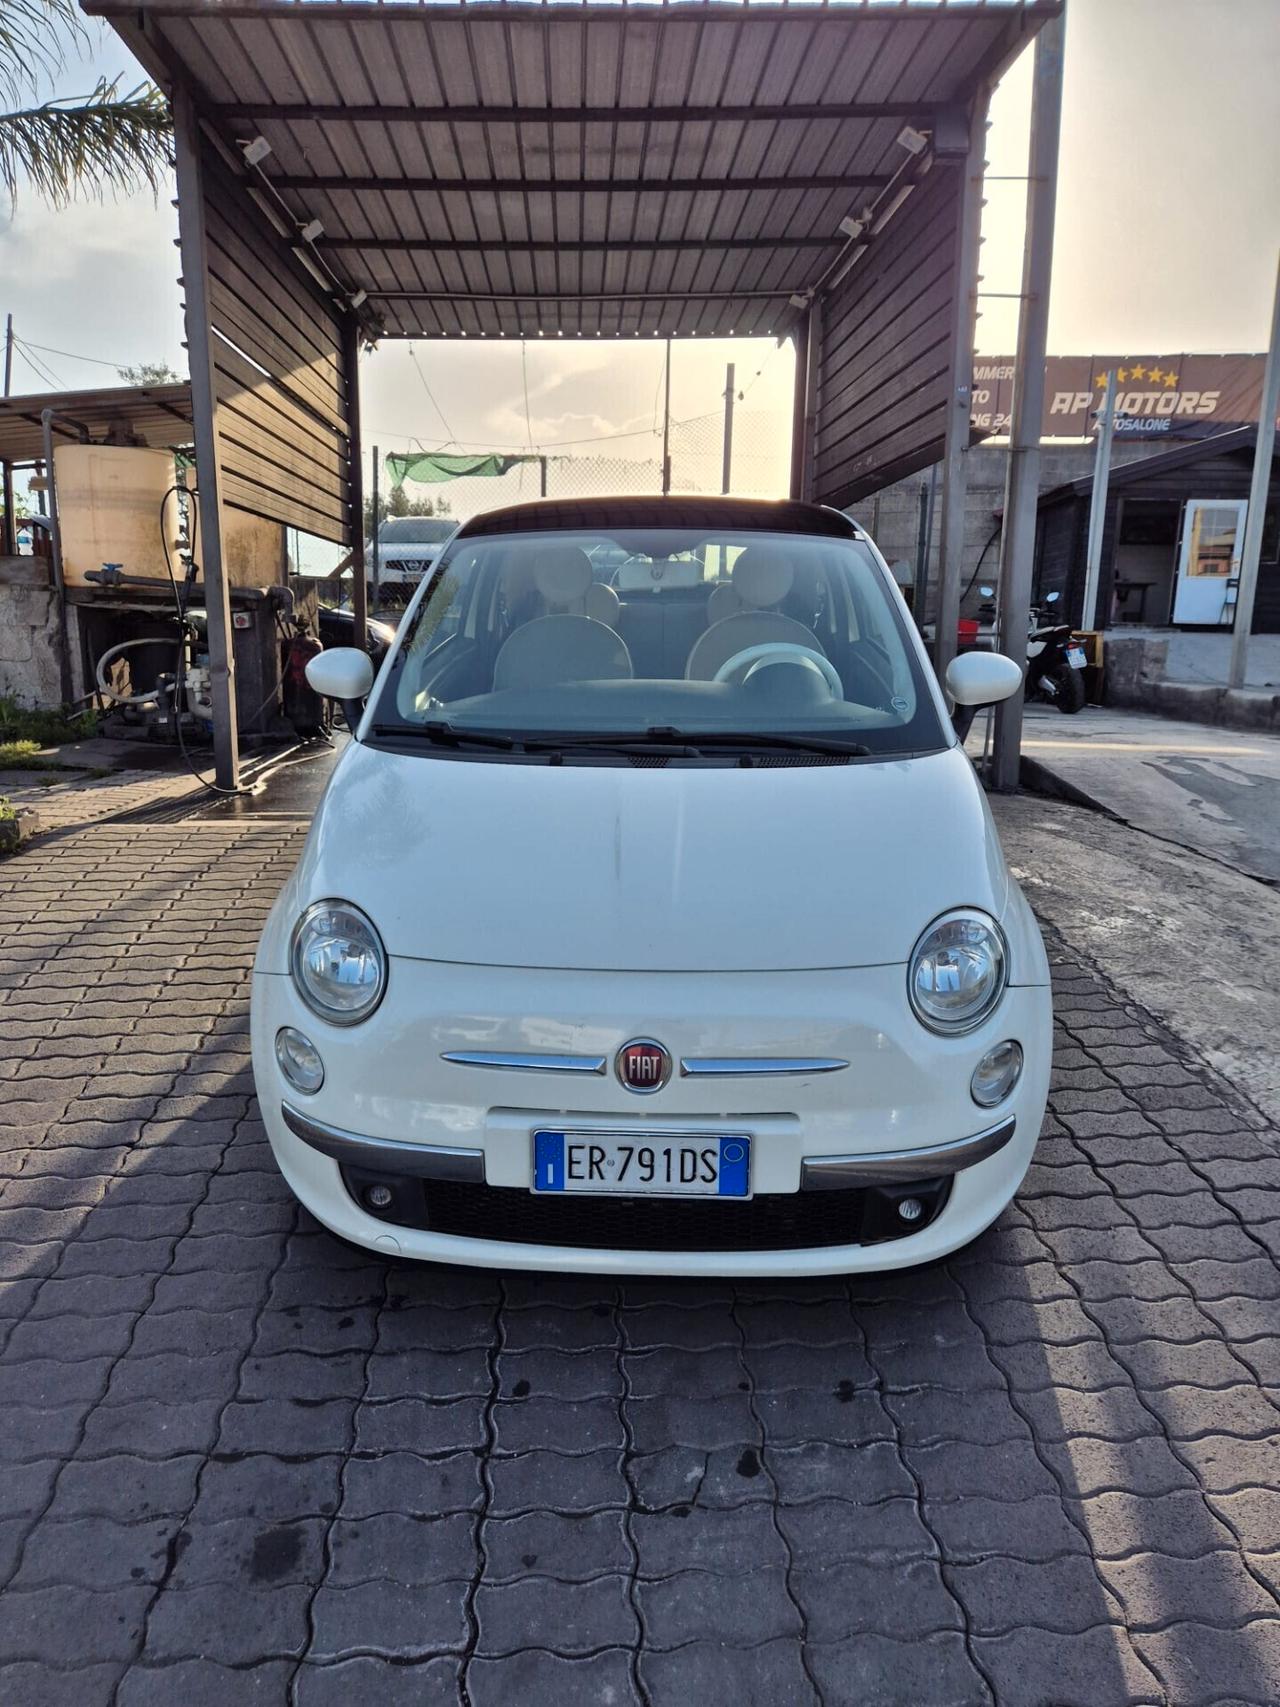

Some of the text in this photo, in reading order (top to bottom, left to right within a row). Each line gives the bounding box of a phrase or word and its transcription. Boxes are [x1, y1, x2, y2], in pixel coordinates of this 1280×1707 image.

[1050, 391, 1221, 414] AP MOTORS
[1092, 418, 1171, 431] ATOSALONE
[629, 1055, 660, 1080] FIAT
